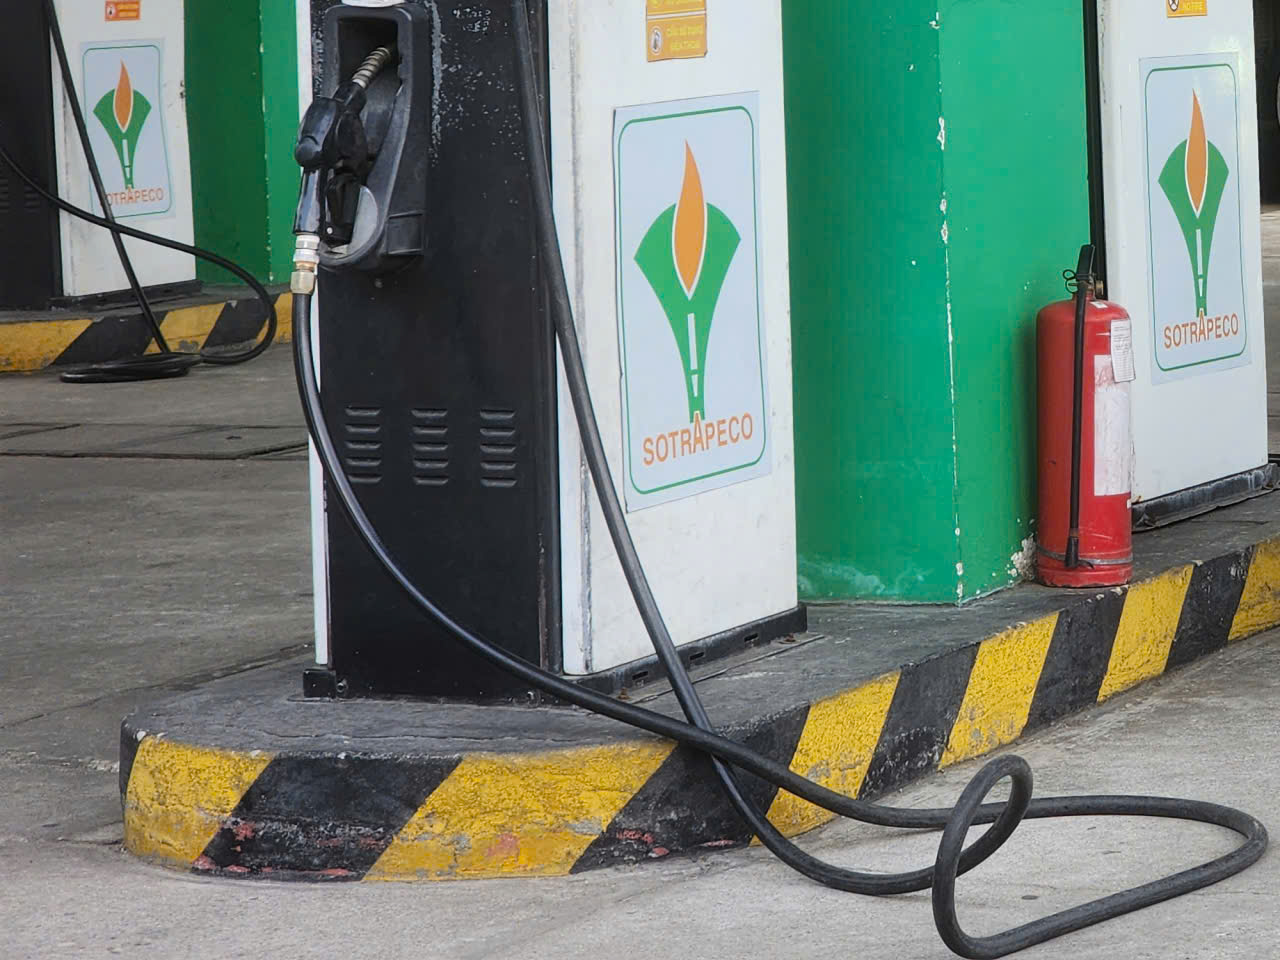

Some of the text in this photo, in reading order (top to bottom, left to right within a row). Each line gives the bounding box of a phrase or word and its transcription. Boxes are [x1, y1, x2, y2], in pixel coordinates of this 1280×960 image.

[101, 186, 164, 208] OTRAPECO
[1163, 310, 1240, 350] SOTRAPECO
[642, 412, 754, 466] SOTRAPECO
